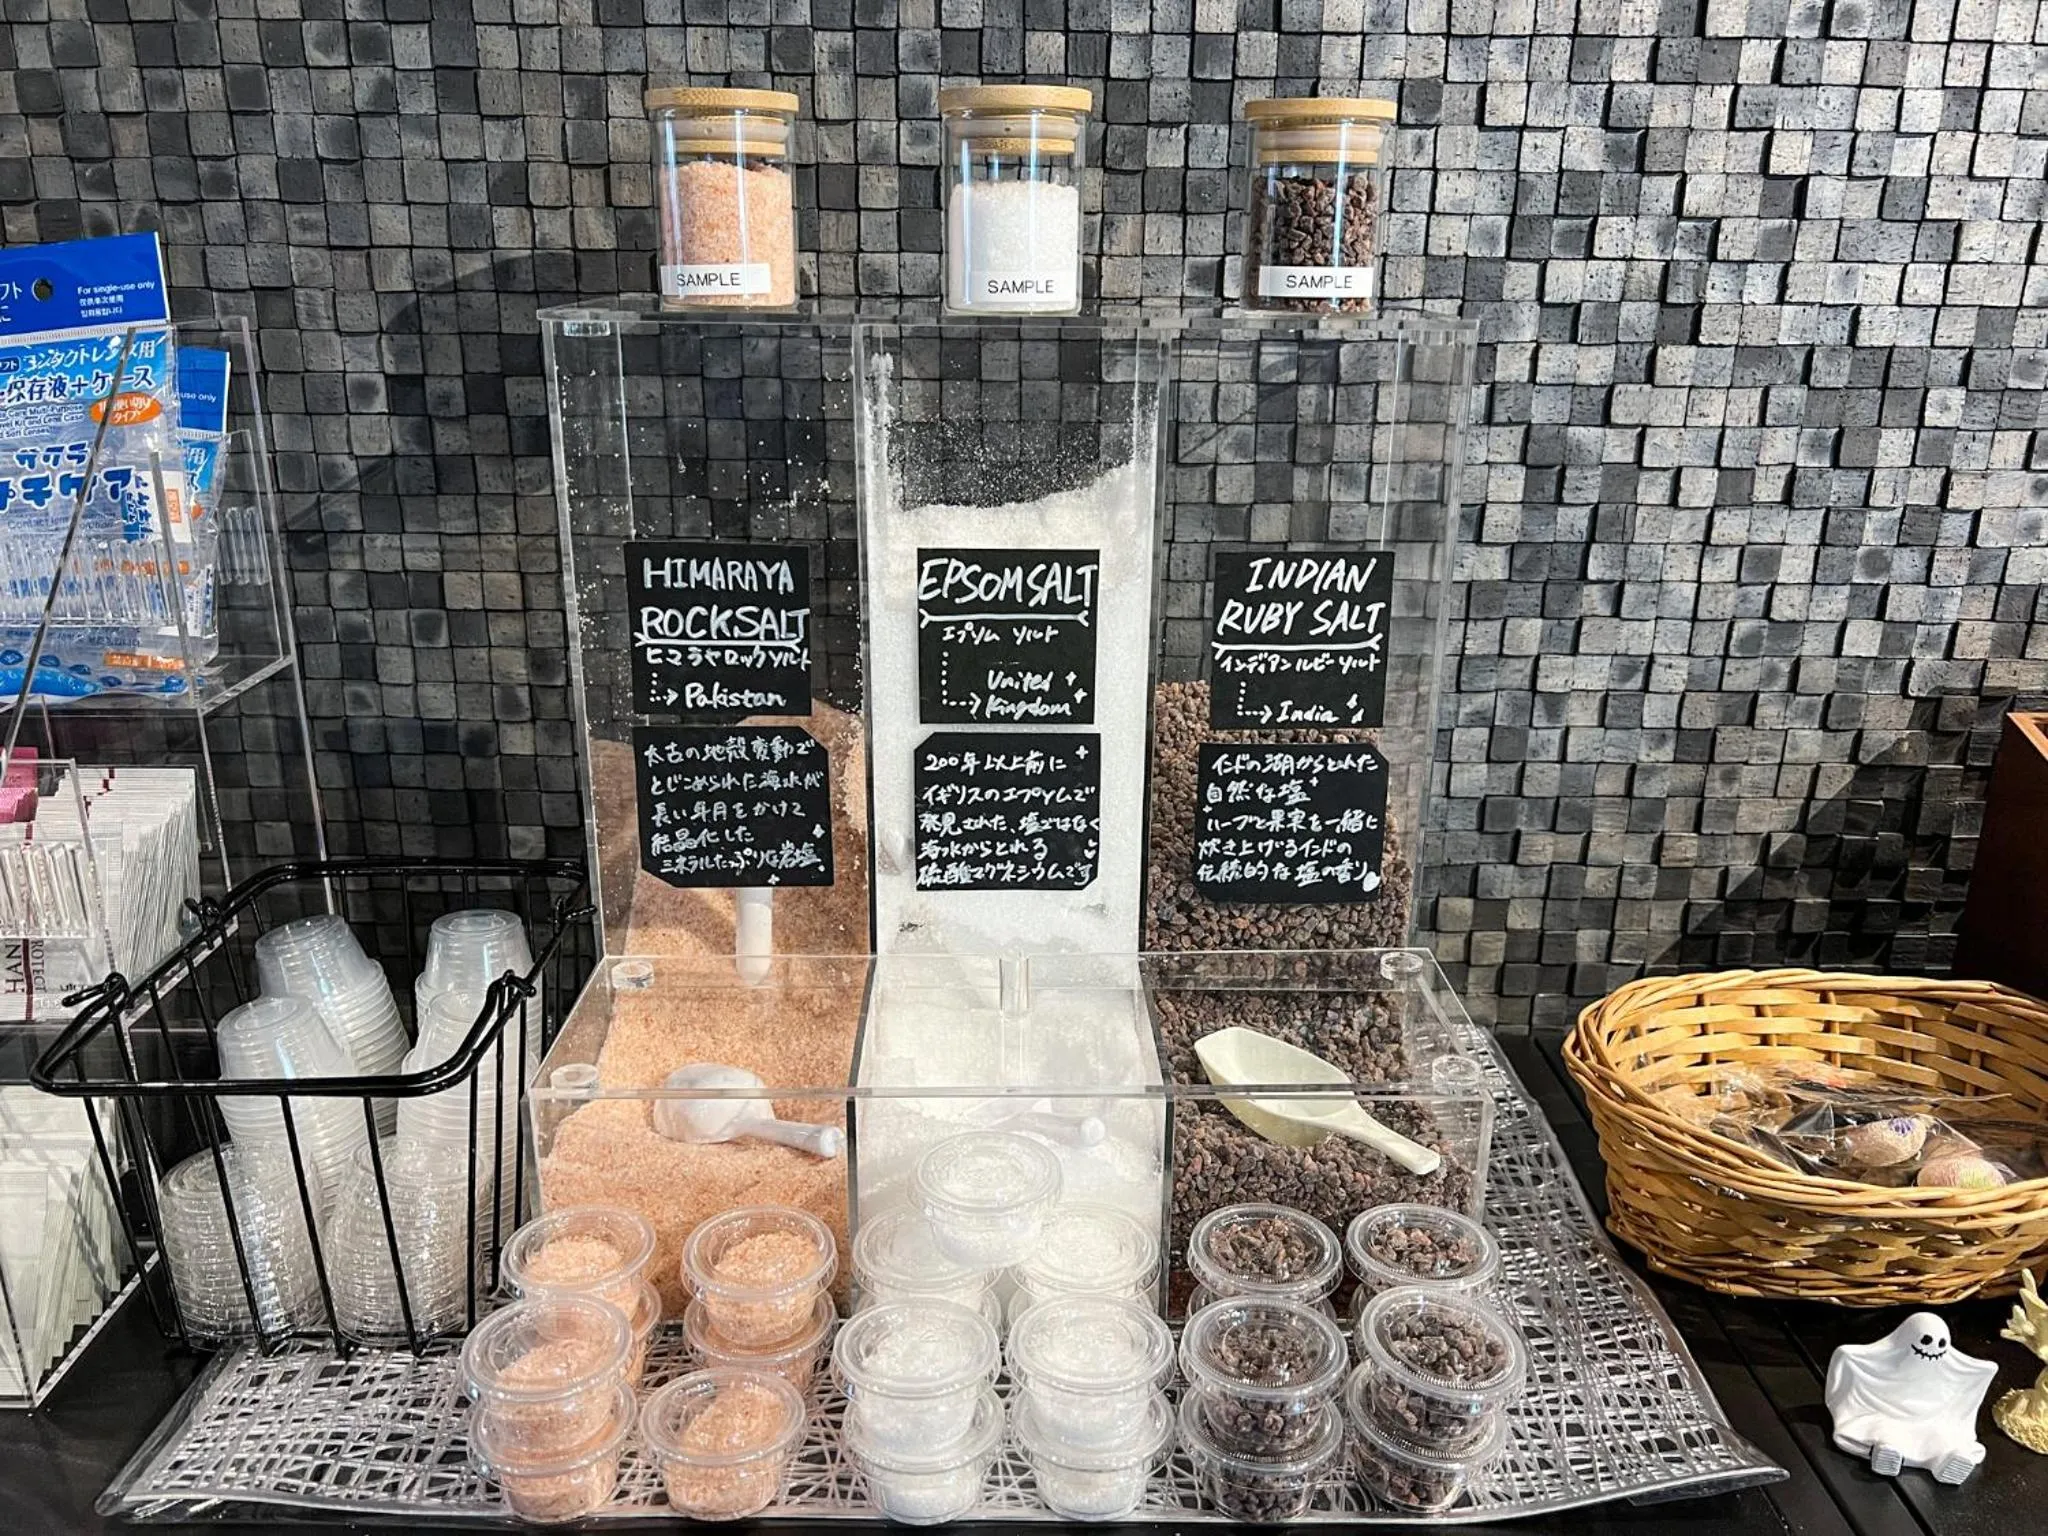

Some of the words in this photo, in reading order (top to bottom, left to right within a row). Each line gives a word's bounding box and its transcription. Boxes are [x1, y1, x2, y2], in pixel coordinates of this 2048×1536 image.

[77, 286, 91, 295] For
[93, 283, 136, 294] single-use
[137, 281, 155, 290] only
[676, 272, 741, 287] SAMPLE
[988, 279, 1055, 294] SAMPLE
[1286, 274, 1353, 289] SAMPLE
[198, 391, 217, 403] only
[643, 557, 795, 595] HIMARAYA
[1245, 557, 1376, 594] INDIAN
[1216, 599, 1304, 636] RUBY
[1309, 599, 1387, 636] SALT
[987, 669, 1053, 692] United
[685, 682, 787, 708] Pakistan
[985, 694, 1072, 721] Kingdom
[1276, 700, 1340, 723] India
[643, 735, 815, 768] 太古の地殻変動で
[923, 750, 1068, 776] 200年以上前に
[651, 770, 824, 796] とじこめられた海水が
[922, 784, 1096, 806] イギリスのエプソムで
[1206, 778, 1311, 806] 自然な塩
[651, 800, 806, 828] 長い年月をかけて
[651, 826, 754, 856] 結晶化した
[917, 838, 1049, 860] 海水からとれる
[916, 861, 1093, 888] 硫酸マグネシウムです
